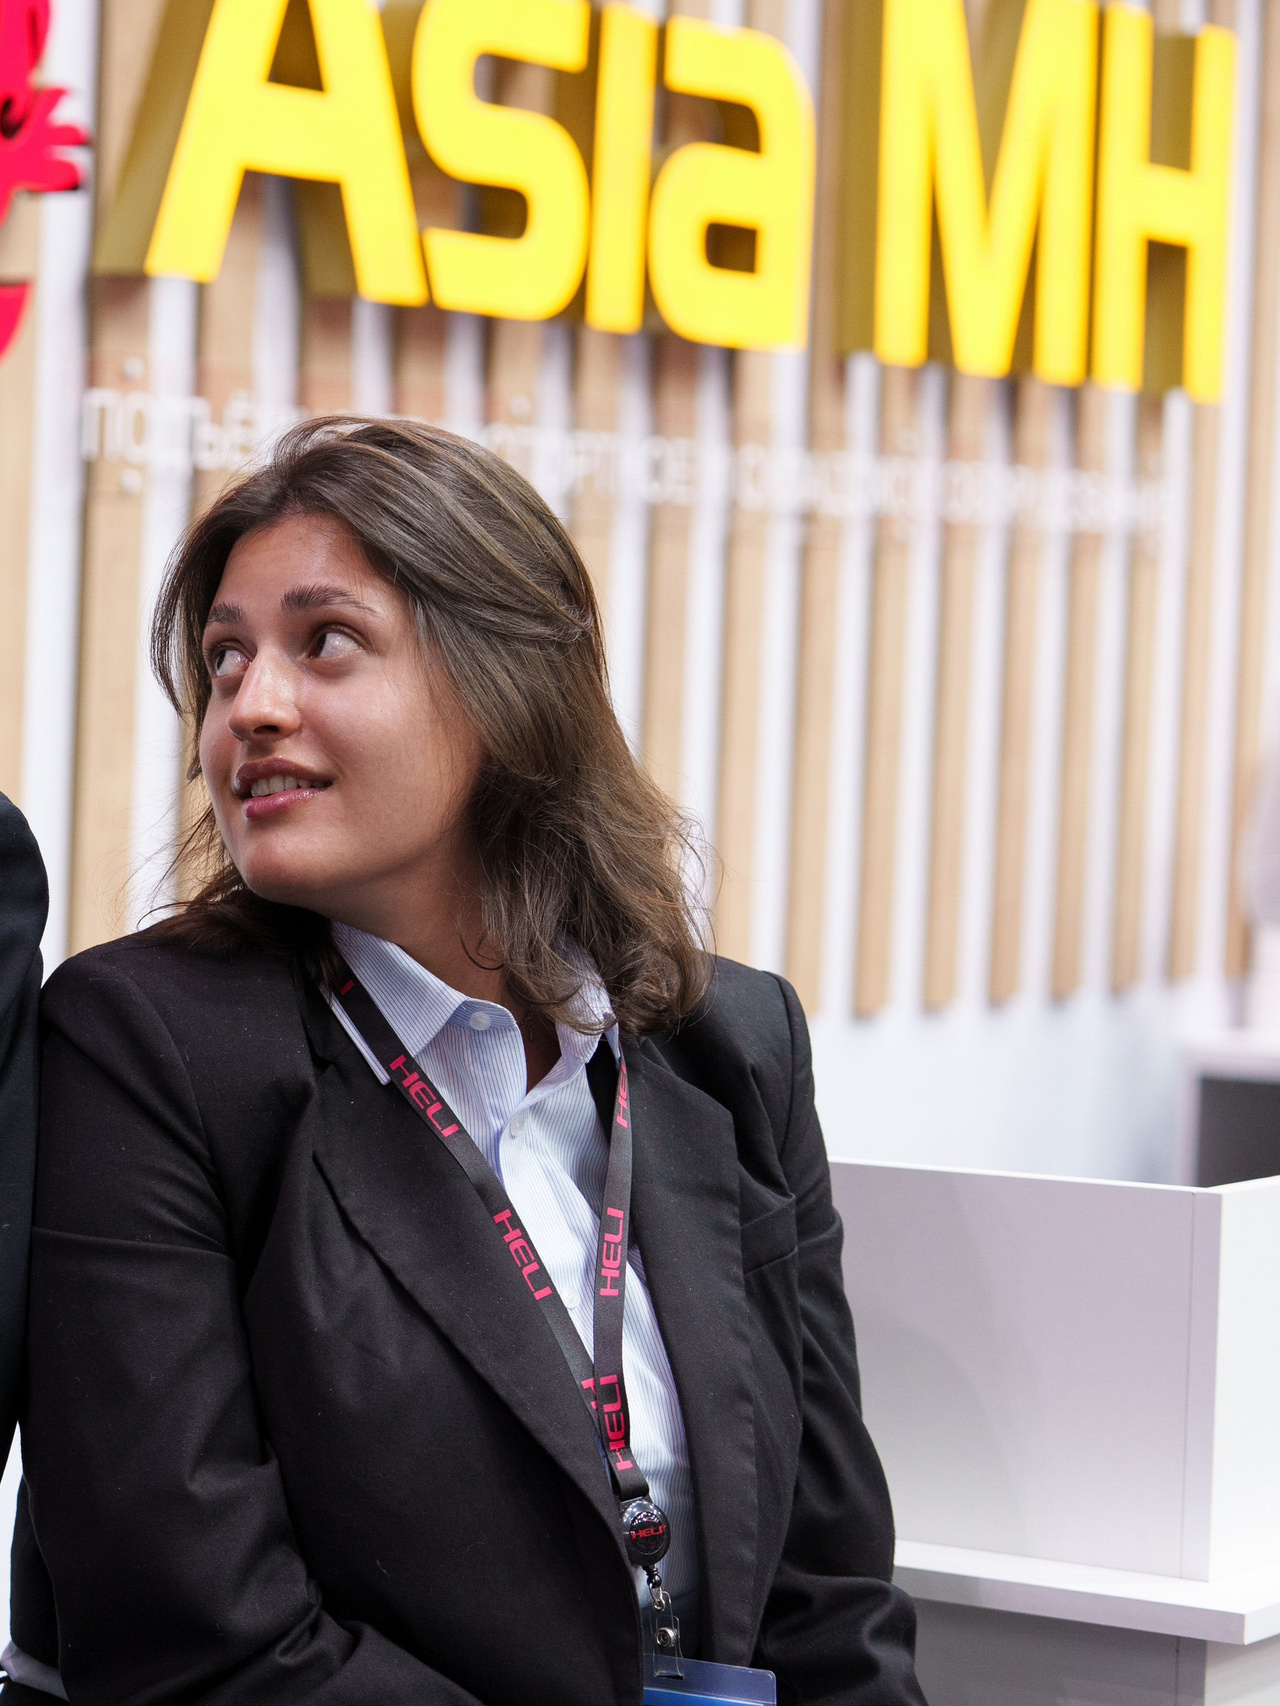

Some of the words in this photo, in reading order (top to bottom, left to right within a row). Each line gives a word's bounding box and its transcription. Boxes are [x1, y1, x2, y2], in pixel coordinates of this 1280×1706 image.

[874, 0, 1237, 404] MH
[389, 1054, 460, 1138] HELI
[493, 1208, 553, 1301] HELI
[599, 1206, 625, 1297] HELI
[599, 1374, 634, 1471] HELI
